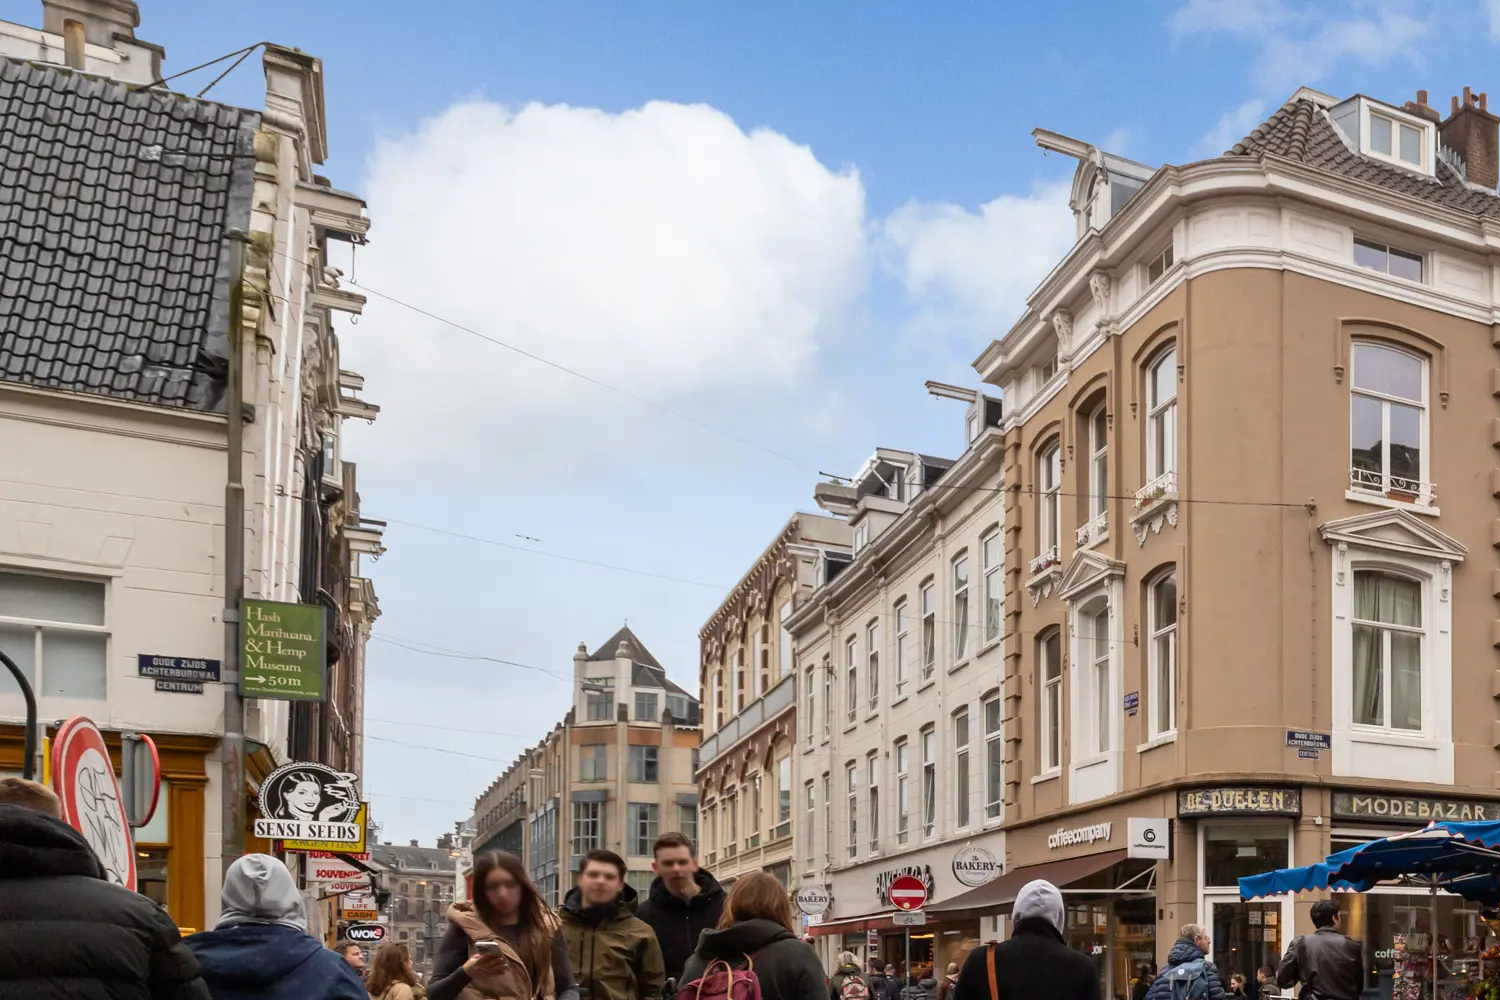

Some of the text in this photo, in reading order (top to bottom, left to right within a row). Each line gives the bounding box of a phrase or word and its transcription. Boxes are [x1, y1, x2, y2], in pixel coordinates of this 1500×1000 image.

[246, 606, 281, 622] Hash
[246, 622, 317, 642] Marihuana
[245, 638, 307, 659] & Hemp
[152, 658, 207, 669] OUDE ZIJDS
[245, 655, 302, 673] Museum
[141, 667, 217, 680] ACHTERBURGWAL
[156, 681, 201, 692] CENTRUM
[1187, 791, 1284, 809] DE DOELEN
[1352, 797, 1486, 820] MODEBAZAR
[257, 822, 356, 840] SENSI SEEDS
[1048, 822, 1112, 849] coffeecompany
[956, 861, 996, 871] BAKERY
[798, 895, 829, 903] BAKERY
